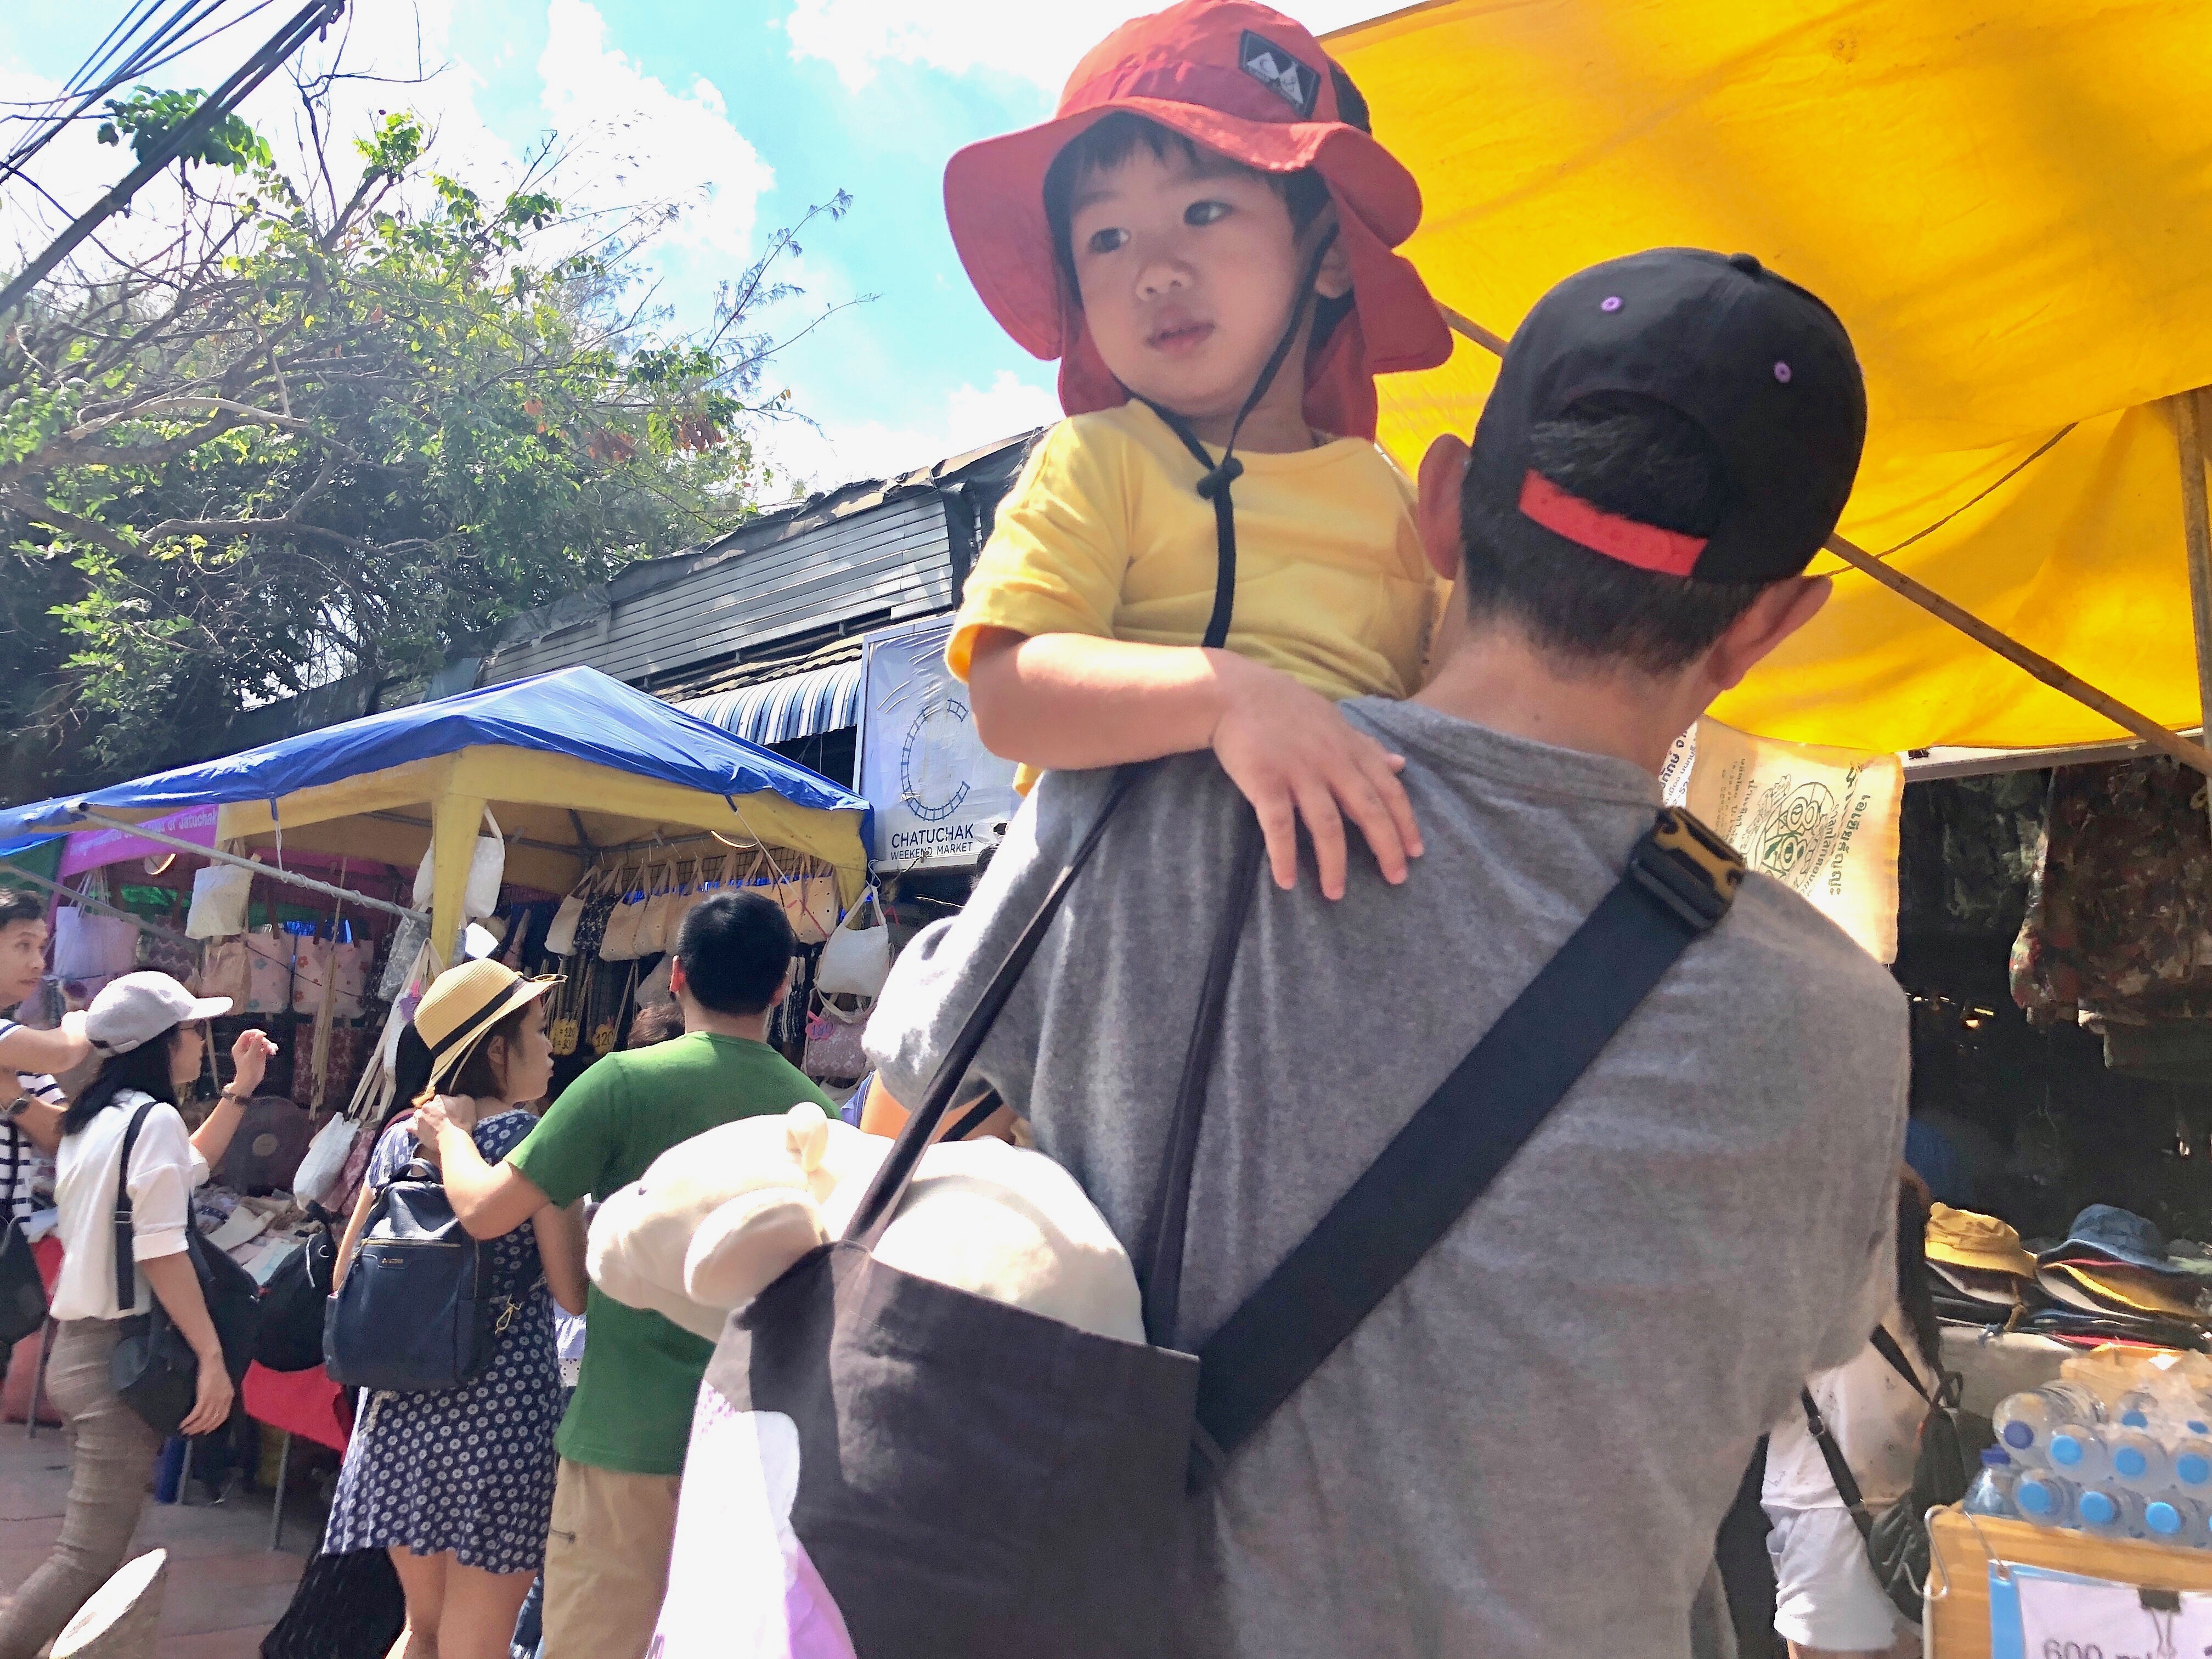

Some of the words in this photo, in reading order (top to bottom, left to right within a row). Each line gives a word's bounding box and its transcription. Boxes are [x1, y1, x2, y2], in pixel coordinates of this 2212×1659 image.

[891, 823, 974, 849] CHATUCHAK
[890, 847, 933, 860] WEEKEND
[936, 842, 973, 855] MARKET
